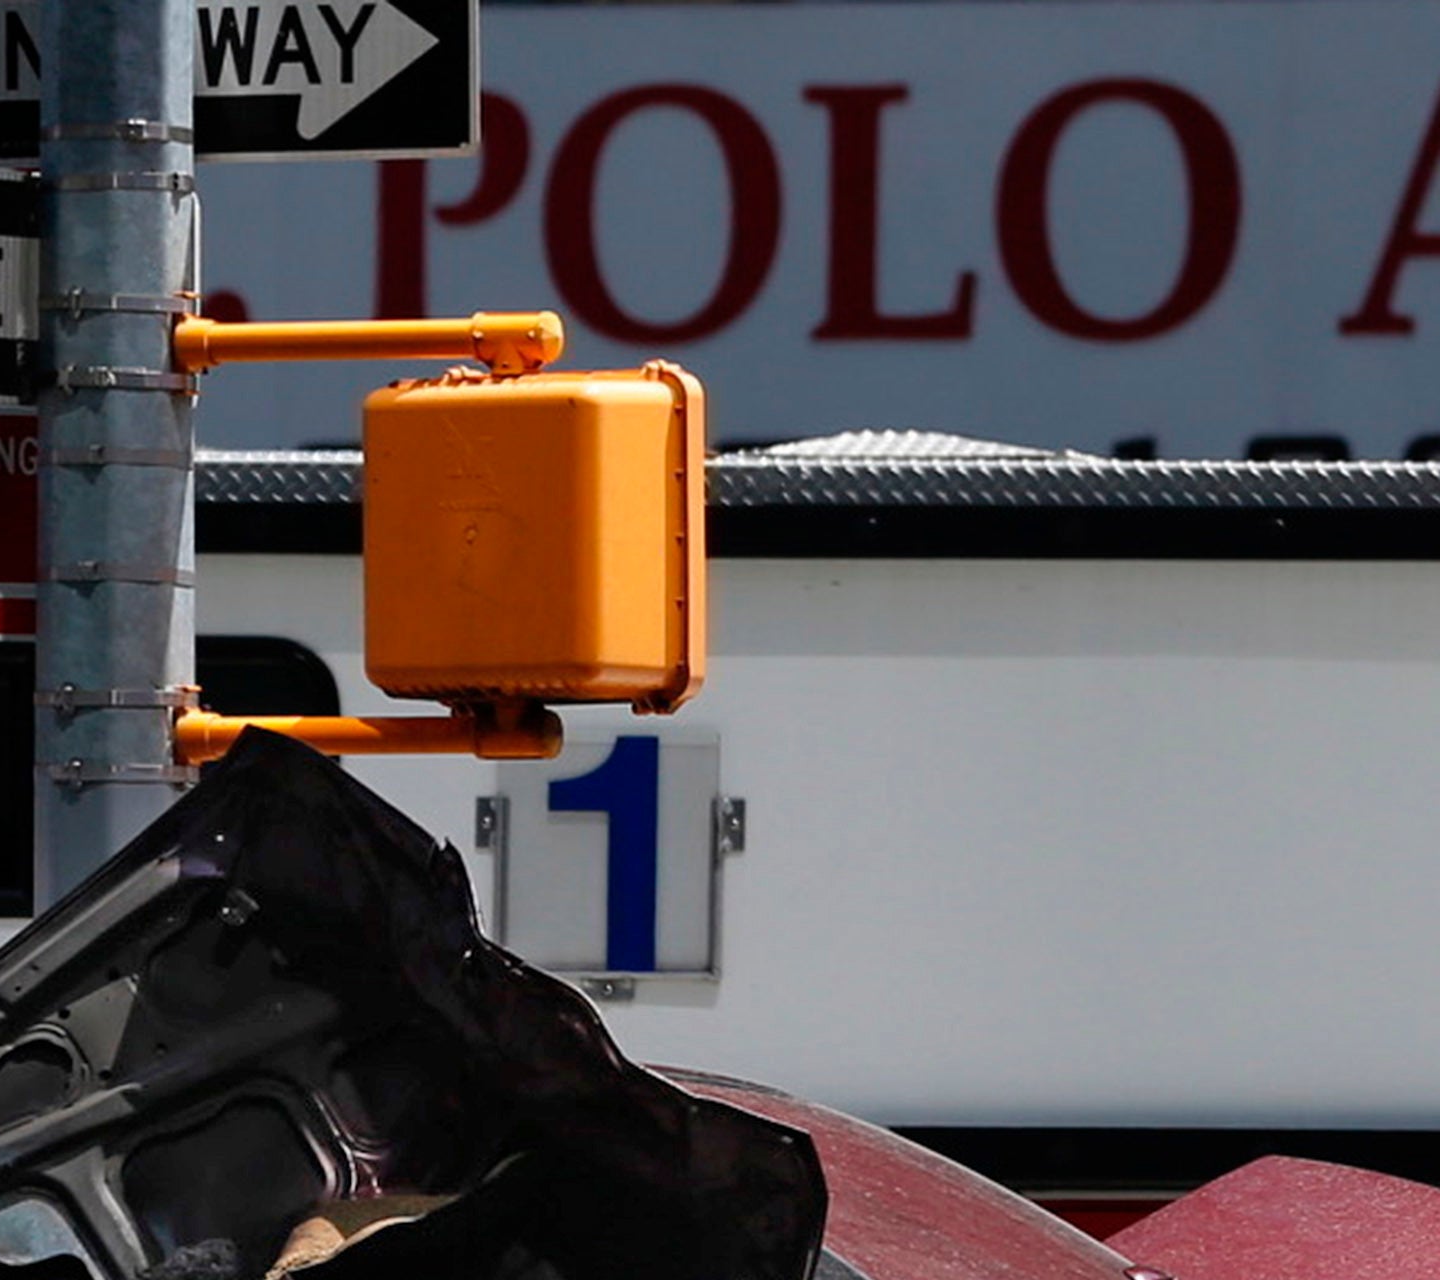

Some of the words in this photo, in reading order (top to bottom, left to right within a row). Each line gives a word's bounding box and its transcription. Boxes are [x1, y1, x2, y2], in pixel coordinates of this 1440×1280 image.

[197, 3, 378, 87] WAY
[373, 75, 1242, 347] POLO
[548, 735, 658, 972] 1
